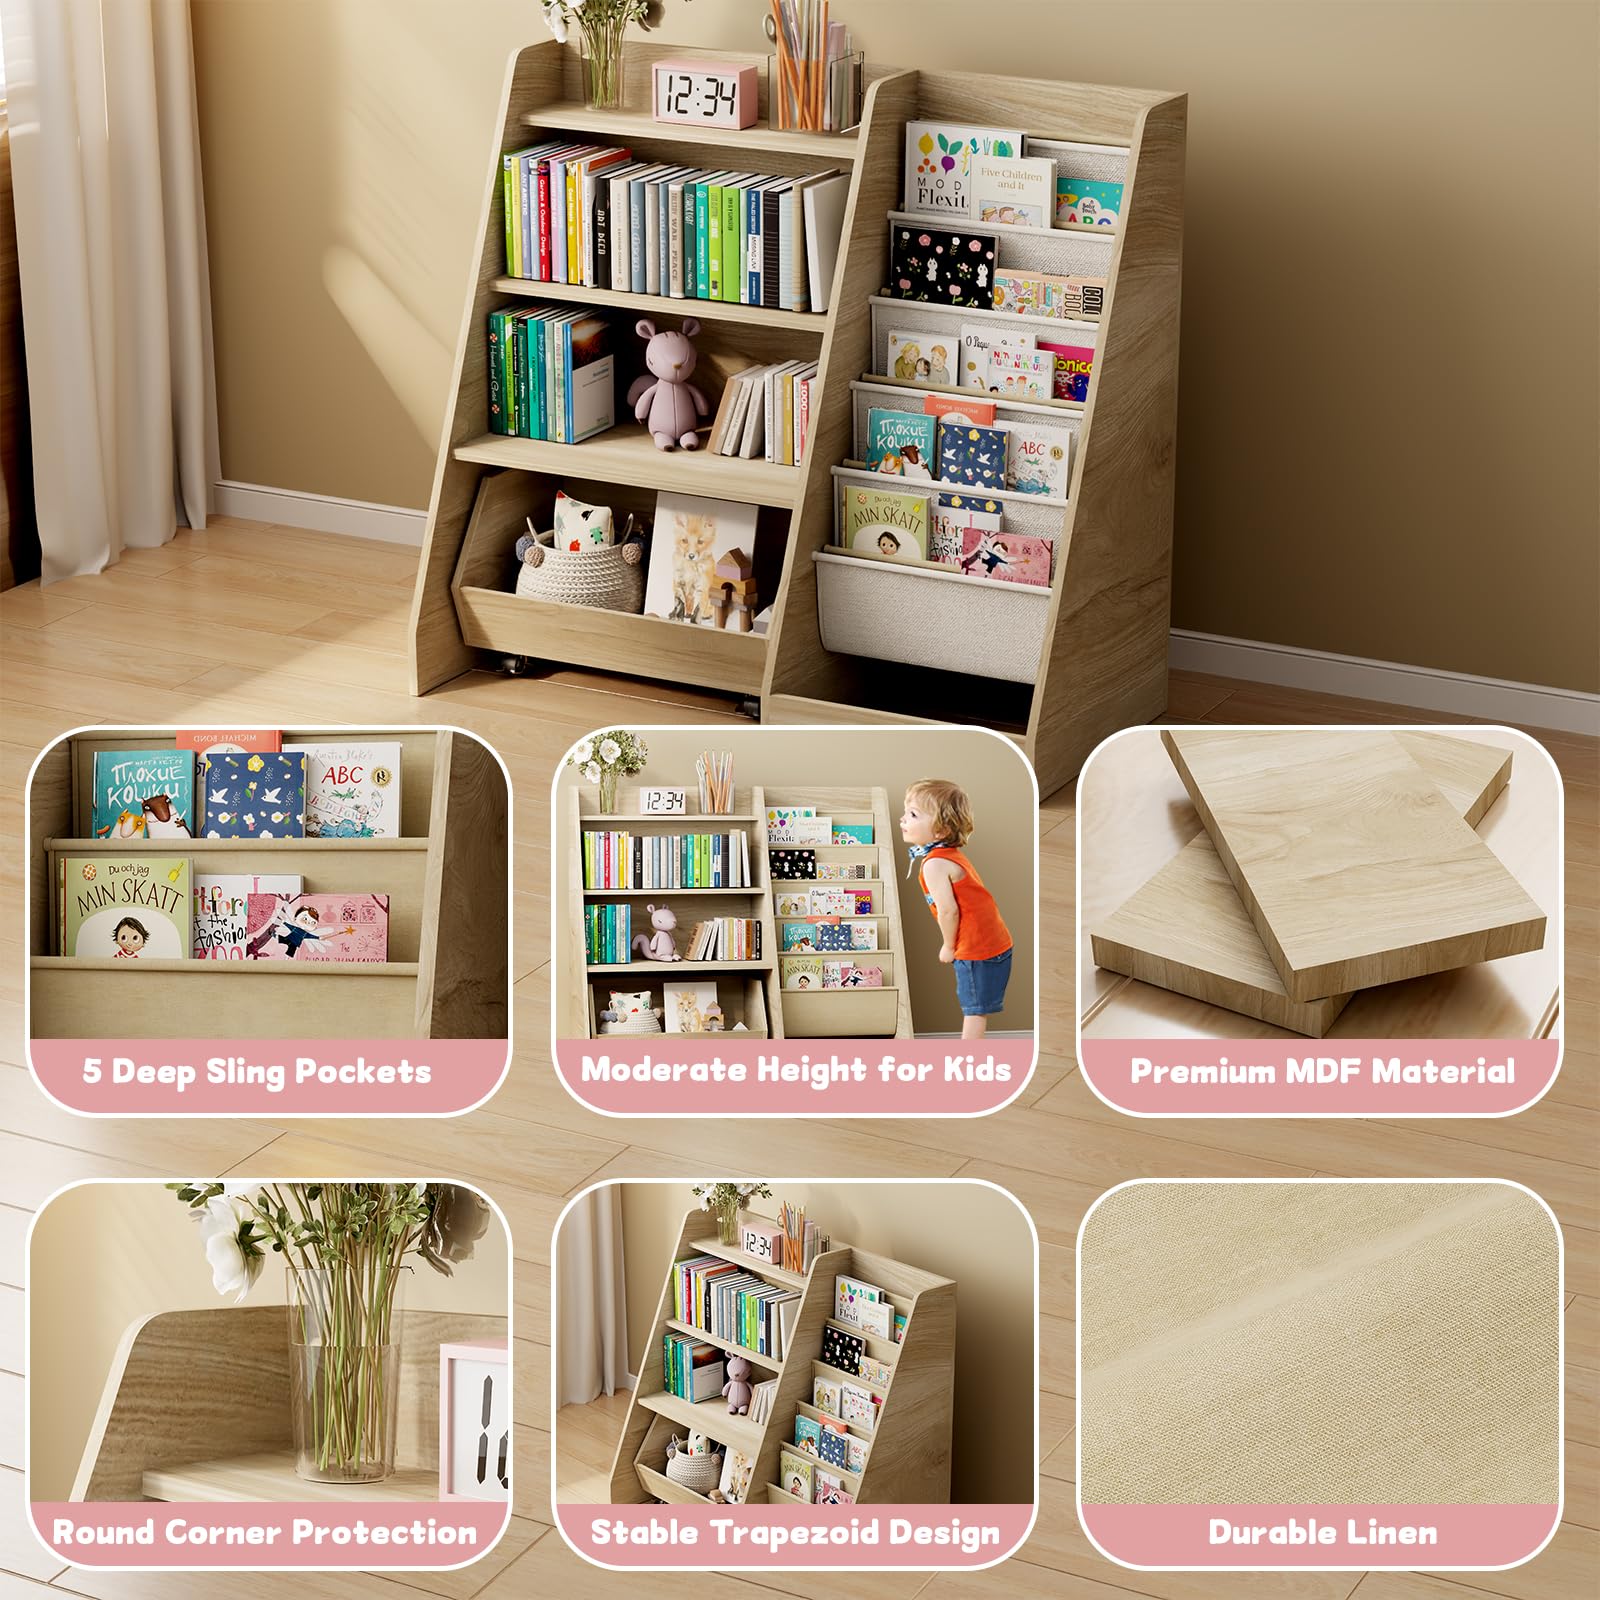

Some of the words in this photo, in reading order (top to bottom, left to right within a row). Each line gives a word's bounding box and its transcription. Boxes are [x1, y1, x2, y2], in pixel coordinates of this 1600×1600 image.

[666, 74, 736, 117] 12:34
[981, 167, 1000, 178] Five
[1002, 169, 1042, 182] Children
[997, 180, 1016, 190] and
[918, 188, 968, 208] Flexit
[598, 210, 606, 226] ART
[966, 336, 972, 346] O
[1018, 442, 1046, 456] ABC
[854, 506, 880, 528] MIN
[882, 506, 924, 534] SKATT
[322, 766, 364, 785] ABC
[646, 791, 684, 812] 12:34
[108, 866, 120, 875] Du
[120, 864, 134, 872] och
[132, 864, 150, 877] jag
[77, 881, 116, 917] MIN
[122, 878, 184, 914] SKATT
[208, 913, 228, 928] the
[340, 943, 350, 952] The
[746, 1232, 772, 1256] 12:34
